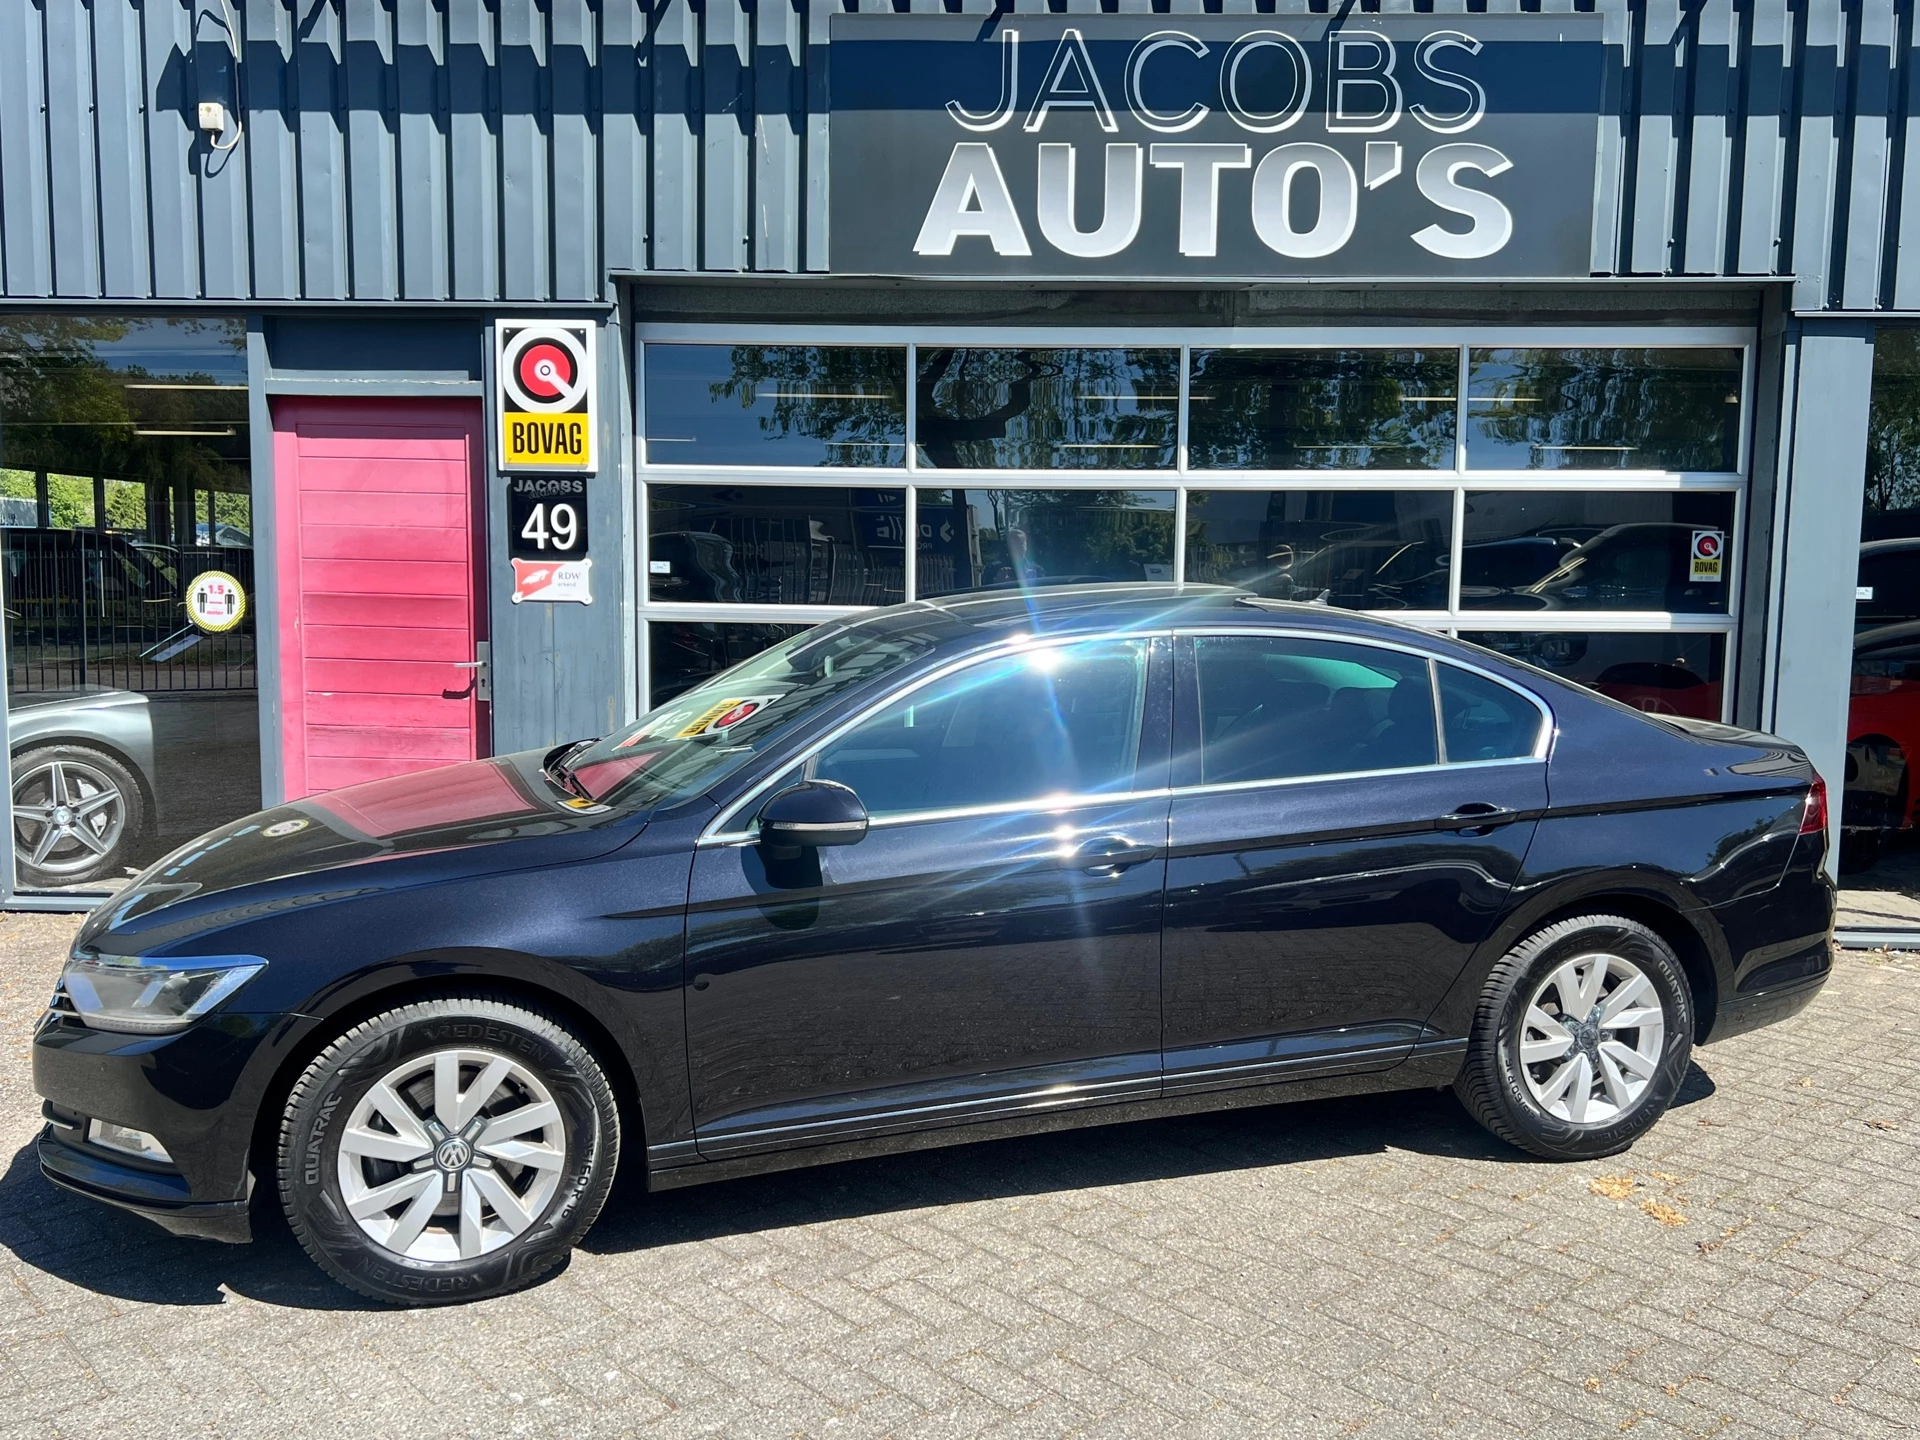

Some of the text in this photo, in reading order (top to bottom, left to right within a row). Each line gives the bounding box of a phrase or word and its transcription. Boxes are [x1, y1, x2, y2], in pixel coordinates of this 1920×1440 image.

[945, 28, 1486, 134] JACOBS
[912, 141, 1514, 259] AUTO'S
[512, 421, 582, 455] BOVAG
[513, 479, 583, 493] JACOBS
[521, 502, 577, 550] 49
[557, 571, 582, 580] RDW
[1694, 561, 1718, 573] BOVAG
[208, 584, 224, 595] 1.5
[1657, 958, 1687, 1025] QUATRAC
[423, 1023, 549, 1062] VREDESTEIN
[304, 1092, 342, 1185] QUATRAC
